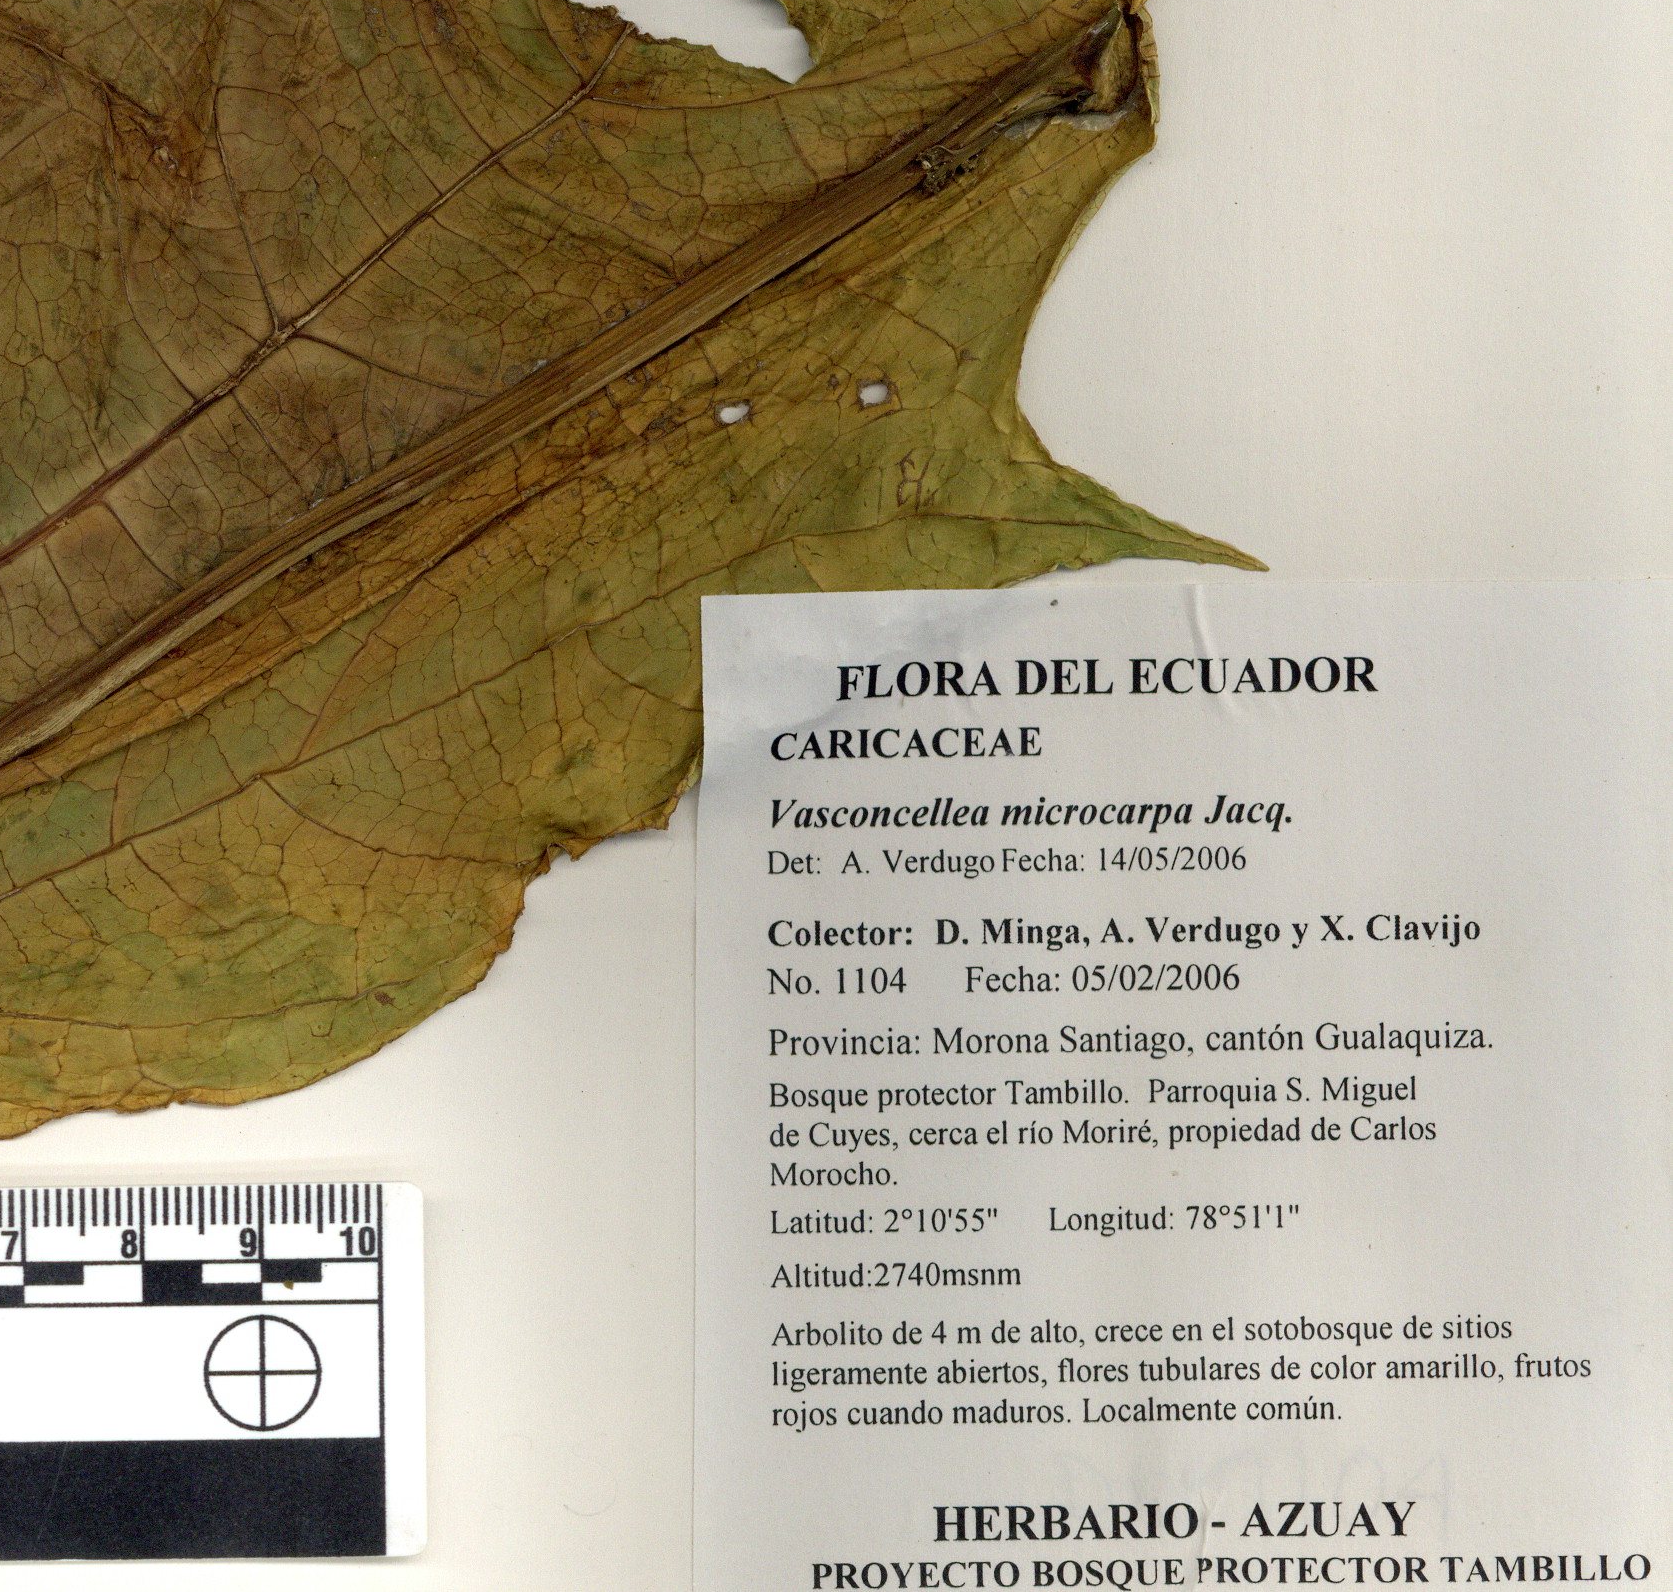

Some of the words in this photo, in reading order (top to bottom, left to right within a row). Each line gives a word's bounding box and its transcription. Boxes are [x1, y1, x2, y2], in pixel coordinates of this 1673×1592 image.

[836, 661, 1001, 701] FLORA
[1015, 659, 1113, 695] DEL
[1129, 657, 1378, 694] ECUADOR
[771, 727, 1041, 761] CARICACEAE
[772, 798, 989, 828] Vasconcellea
[1001, 797, 1192, 833] microcarpa
[1205, 795, 1291, 832] Jacq.
[768, 851, 820, 874] Det:
[841, 851, 869, 874] A.
[883, 849, 994, 879] Verdugo
[1003, 848, 1085, 872] Fecha:
[1100, 846, 1246, 871] 14/05/2006
[768, 920, 912, 947] Colector:
[936, 919, 968, 945] D.
[982, 918, 1089, 951] Minga,
[1101, 918, 1133, 943] A.
[1146, 917, 1280, 949] Verdugo
[1292, 924, 1308, 949] y
[1321, 915, 1353, 941] X.
[1367, 914, 1480, 947] Clavijo
[767, 969, 819, 994] No.
[837, 967, 906, 994] 1104
[966, 966, 1059, 992] Fecha:
[1072, 964, 1239, 991] 05/02/2006
[770, 1028, 919, 1056] Provincia:
[934, 1027, 1049, 1054] Morona
[1061, 1025, 1193, 1059] Santiago,
[1206, 1024, 1303, 1051] cantón
[1316, 1022, 1492, 1057] Gualaquiza.
[770, 1083, 868, 1113] Bosque
[878, 1084, 996, 1112] protector
[1005, 1079, 1128, 1104] Tambillo.
[1149, 1079, 1277, 1109] Parroquia
[1287, 1077, 1309, 1101] S.
[1323, 1076, 1415, 1107] Miguel
[770, 1123, 799, 1147] de
[809, 1122, 898, 1153] Cuyes,
[909, 1128, 978, 1145] cerca
[987, 1120, 1007, 1145] el
[1019, 1121, 1053, 1144] río
[1063, 1119, 1158, 1147] Moriré,
[1169, 1117, 1300, 1149] propiedad
[1311, 1117, 1340, 1141] de
[1351, 1116, 1436, 1140] Carlos
[771, 1161, 897, 1186] Morocho.
[771, 1209, 872, 1234] Latitud:
[1050, 1206, 1173, 1237] Longitud:
[1, 1230, 19, 1260] 7
[121, 1229, 138, 1259] 8
[239, 1228, 258, 1258] 9
[339, 1226, 376, 1256] 10
[771, 1262, 1021, 1288] Altitud:2740msnm
[772, 1321, 882, 1346] Arbolito
[893, 1321, 922, 1345] de
[932, 1321, 946, 1344] 4
[958, 1327, 981, 1344] m
[992, 1320, 1020, 1344] de
[1031, 1319, 1084, 1347] alto,
[1095, 1325, 1162, 1342] crece
[1173, 1324, 1202, 1341] en
[1213, 1317, 1233, 1341] el
[1245, 1316, 1392, 1346] sotobosque
[1403, 1315, 1432, 1339] de
[1443, 1318, 1511, 1339] sitios
[773, 1361, 927, 1392] ligeramente
[937, 1359, 1047, 1387] abiertos,
[1058, 1358, 1128, 1382] flores
[1139, 1356, 1260, 1381] tubulares
[1271, 1356, 1300, 1379] de
[1311, 1355, 1376, 1379] color
[1387, 1354, 1503, 1380] amarillo,
[1515, 1353, 1590, 1377] frutos
[773, 1401, 837, 1432] rojos
[848, 1400, 942, 1425] cuando
[953, 1399, 1071, 1423] maduros.
[1083, 1397, 1236, 1422] Localmente
[1247, 1396, 1341, 1420] común.
[933, 1503, 1198, 1542] HERBARIO
[1240, 1502, 1416, 1537] AZUAY
[812, 1561, 1019, 1589] PROYECTO
[1033, 1559, 1184, 1591] BOSQUE
[1197, 1557, 1429, 1583] PROTECTOR
[1440, 1554, 1650, 1582] TAMBILLO
